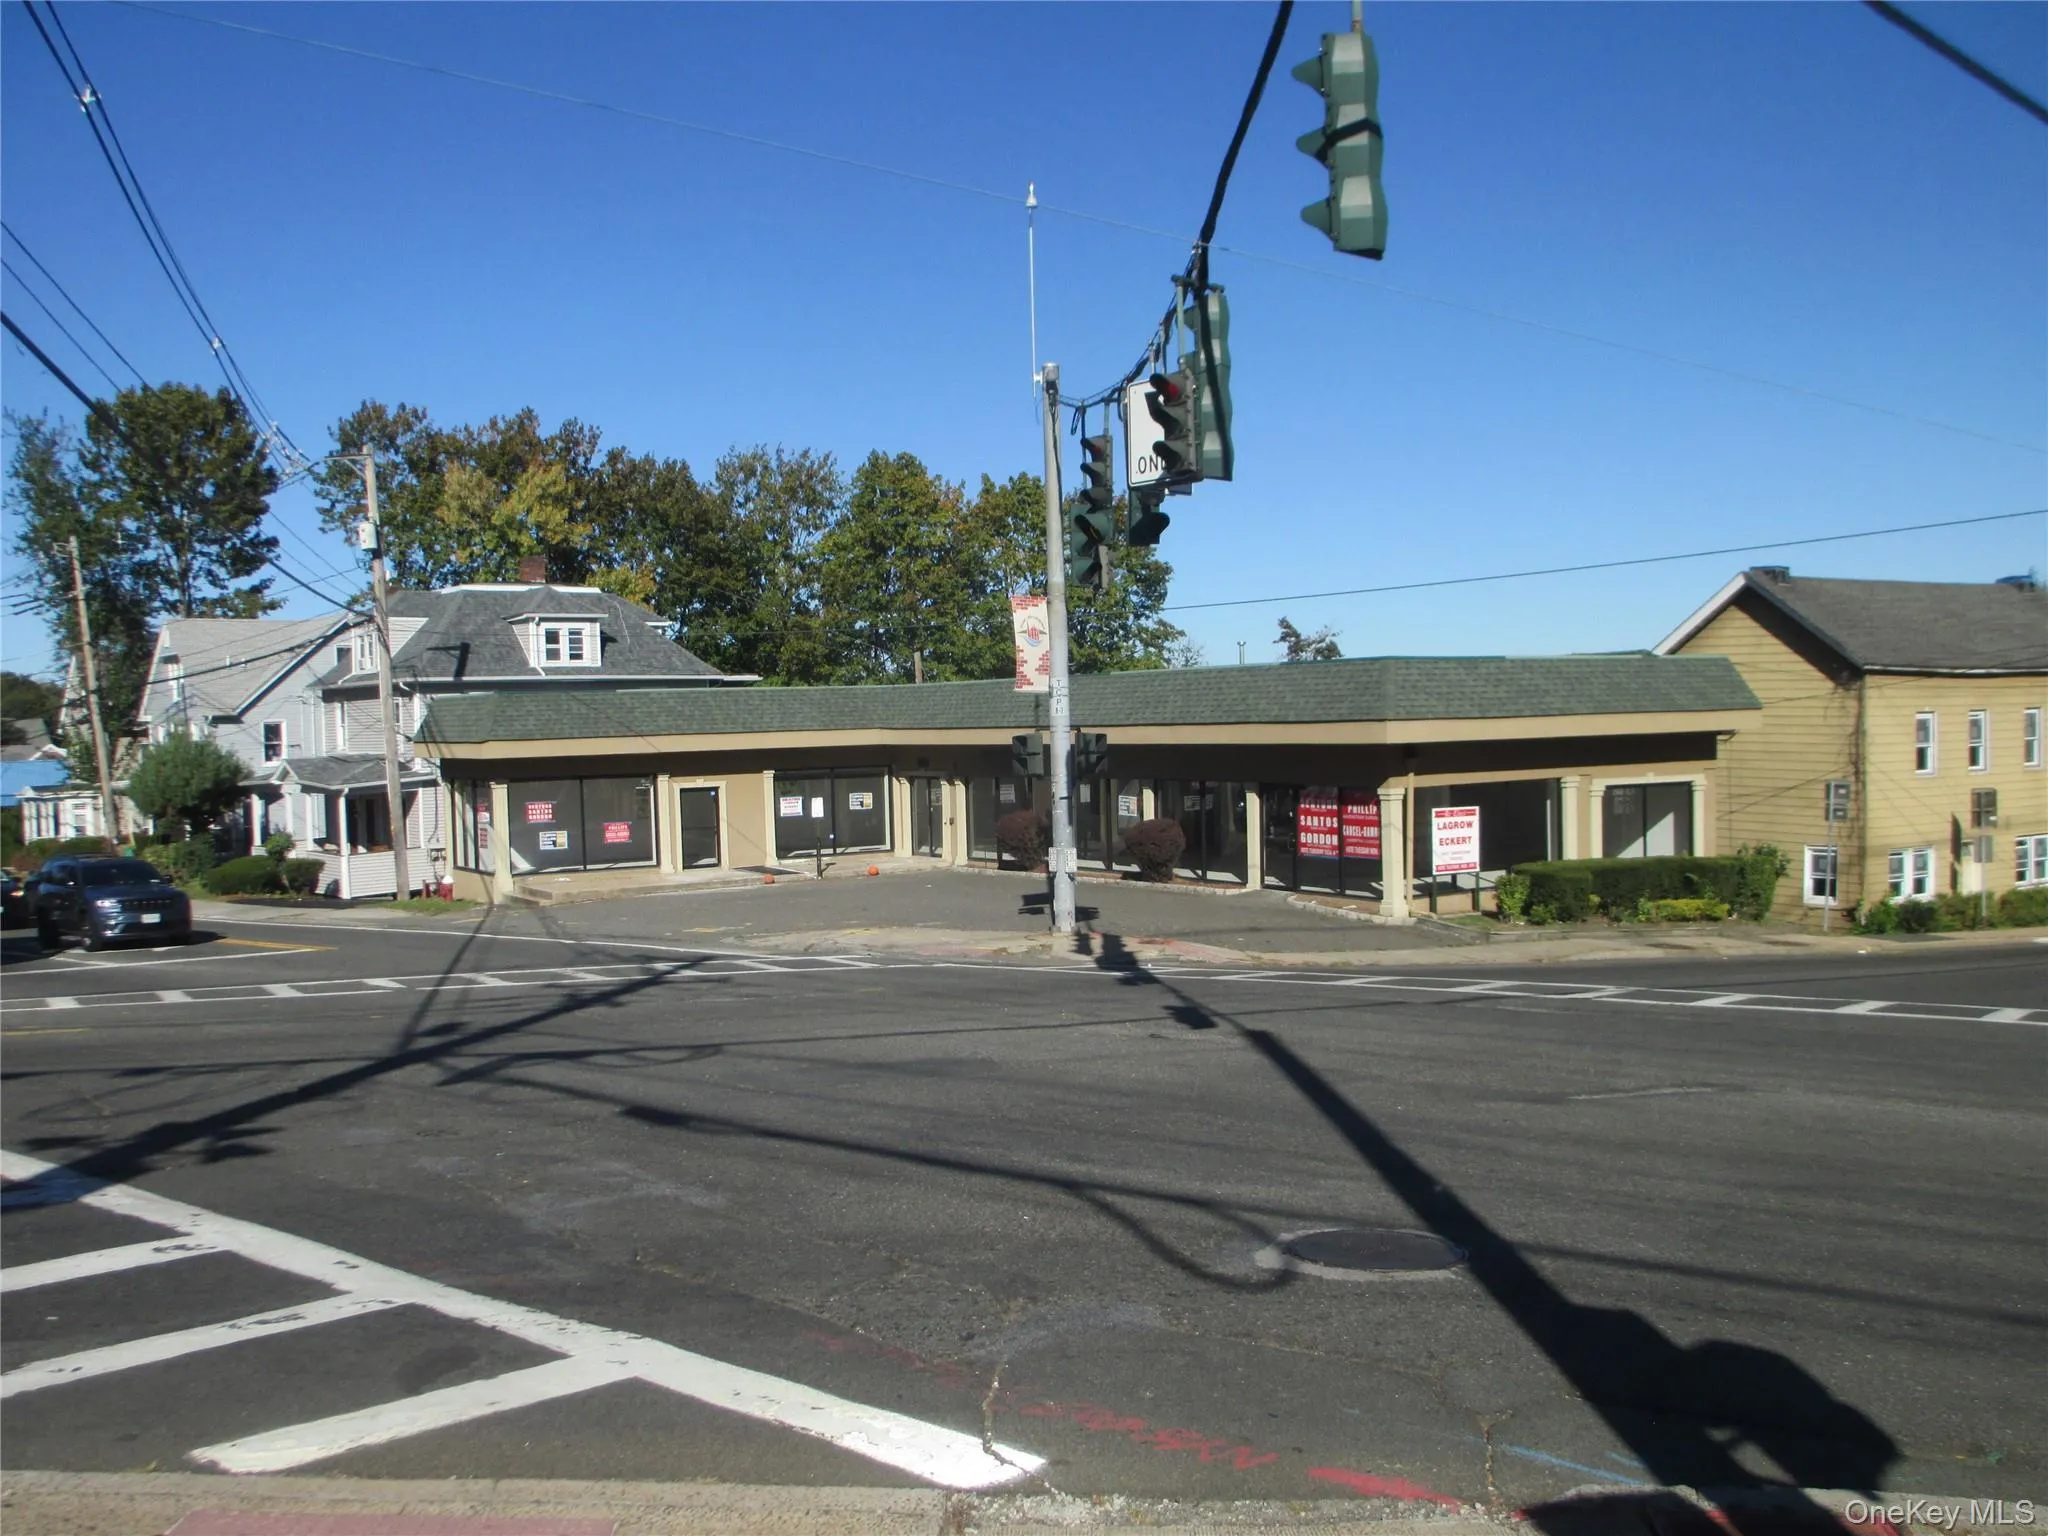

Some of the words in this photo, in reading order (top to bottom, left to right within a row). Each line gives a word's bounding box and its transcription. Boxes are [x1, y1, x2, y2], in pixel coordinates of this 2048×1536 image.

[1300, 815, 1338, 828] SANTOS
[1437, 820, 1474, 831] LAGROW
[1300, 832, 1339, 846] GORDON
[1439, 836, 1473, 847] ECKERT
